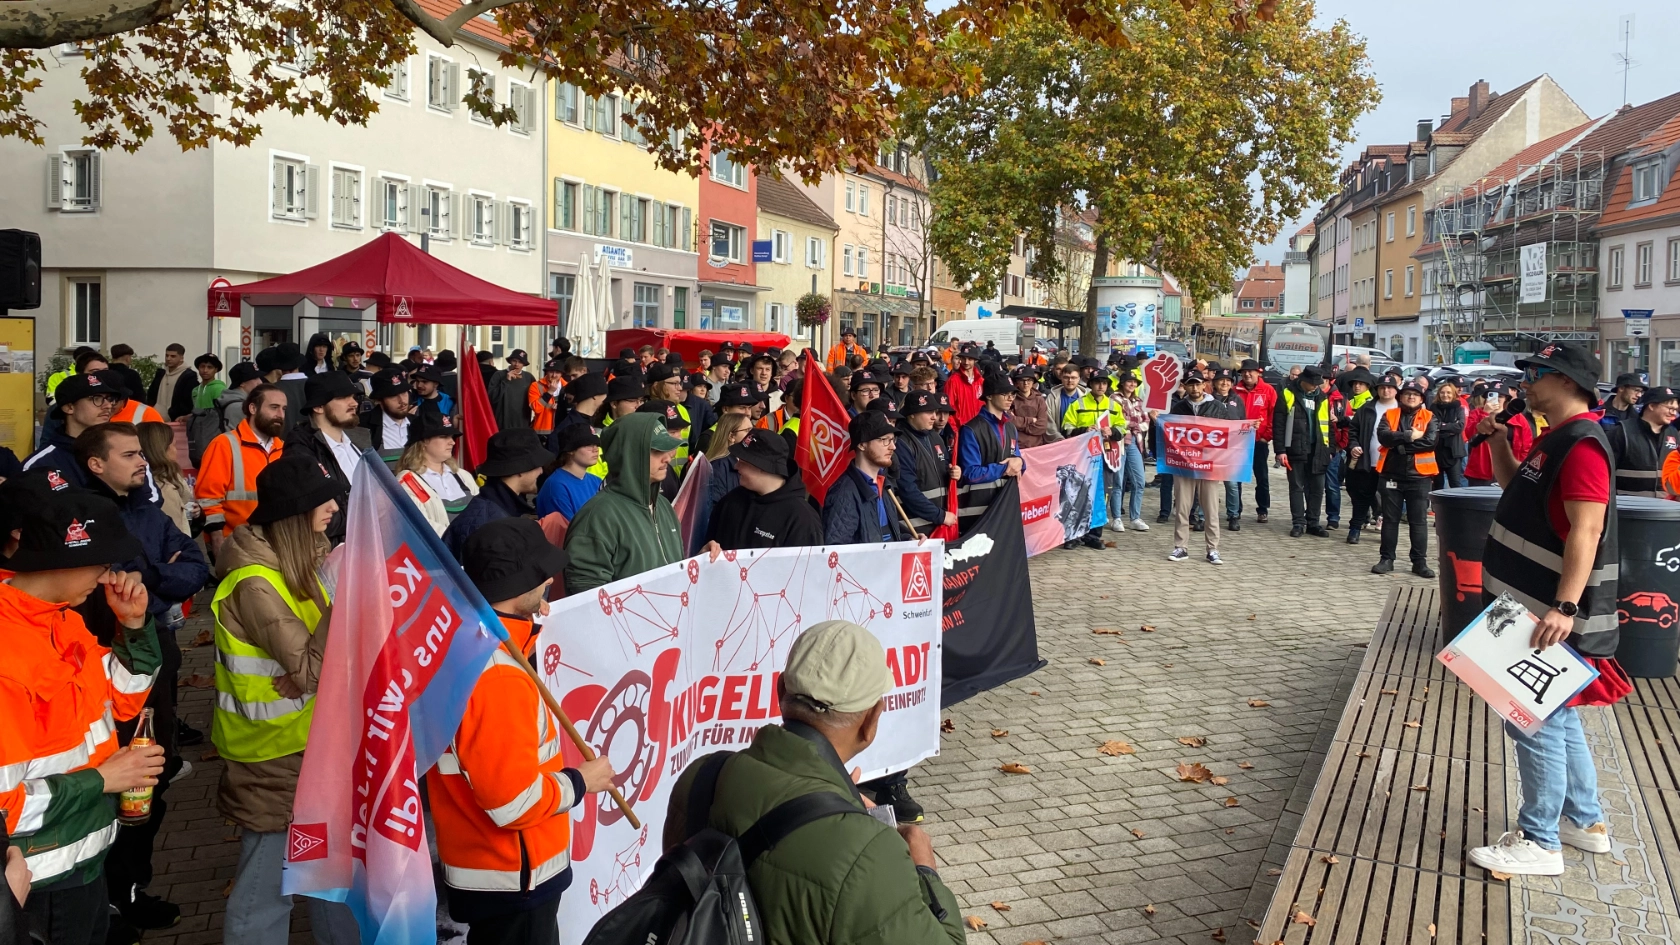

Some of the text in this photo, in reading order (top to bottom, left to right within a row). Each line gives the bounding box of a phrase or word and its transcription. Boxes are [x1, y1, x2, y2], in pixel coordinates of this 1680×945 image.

[602, 245, 626, 256] ATLANTIC
[1279, 341, 1314, 351] Walther
[1167, 447, 1201, 457] sind nicht
[903, 608, 932, 619] Schweinfurt
[702, 723, 733, 747] FÜR
